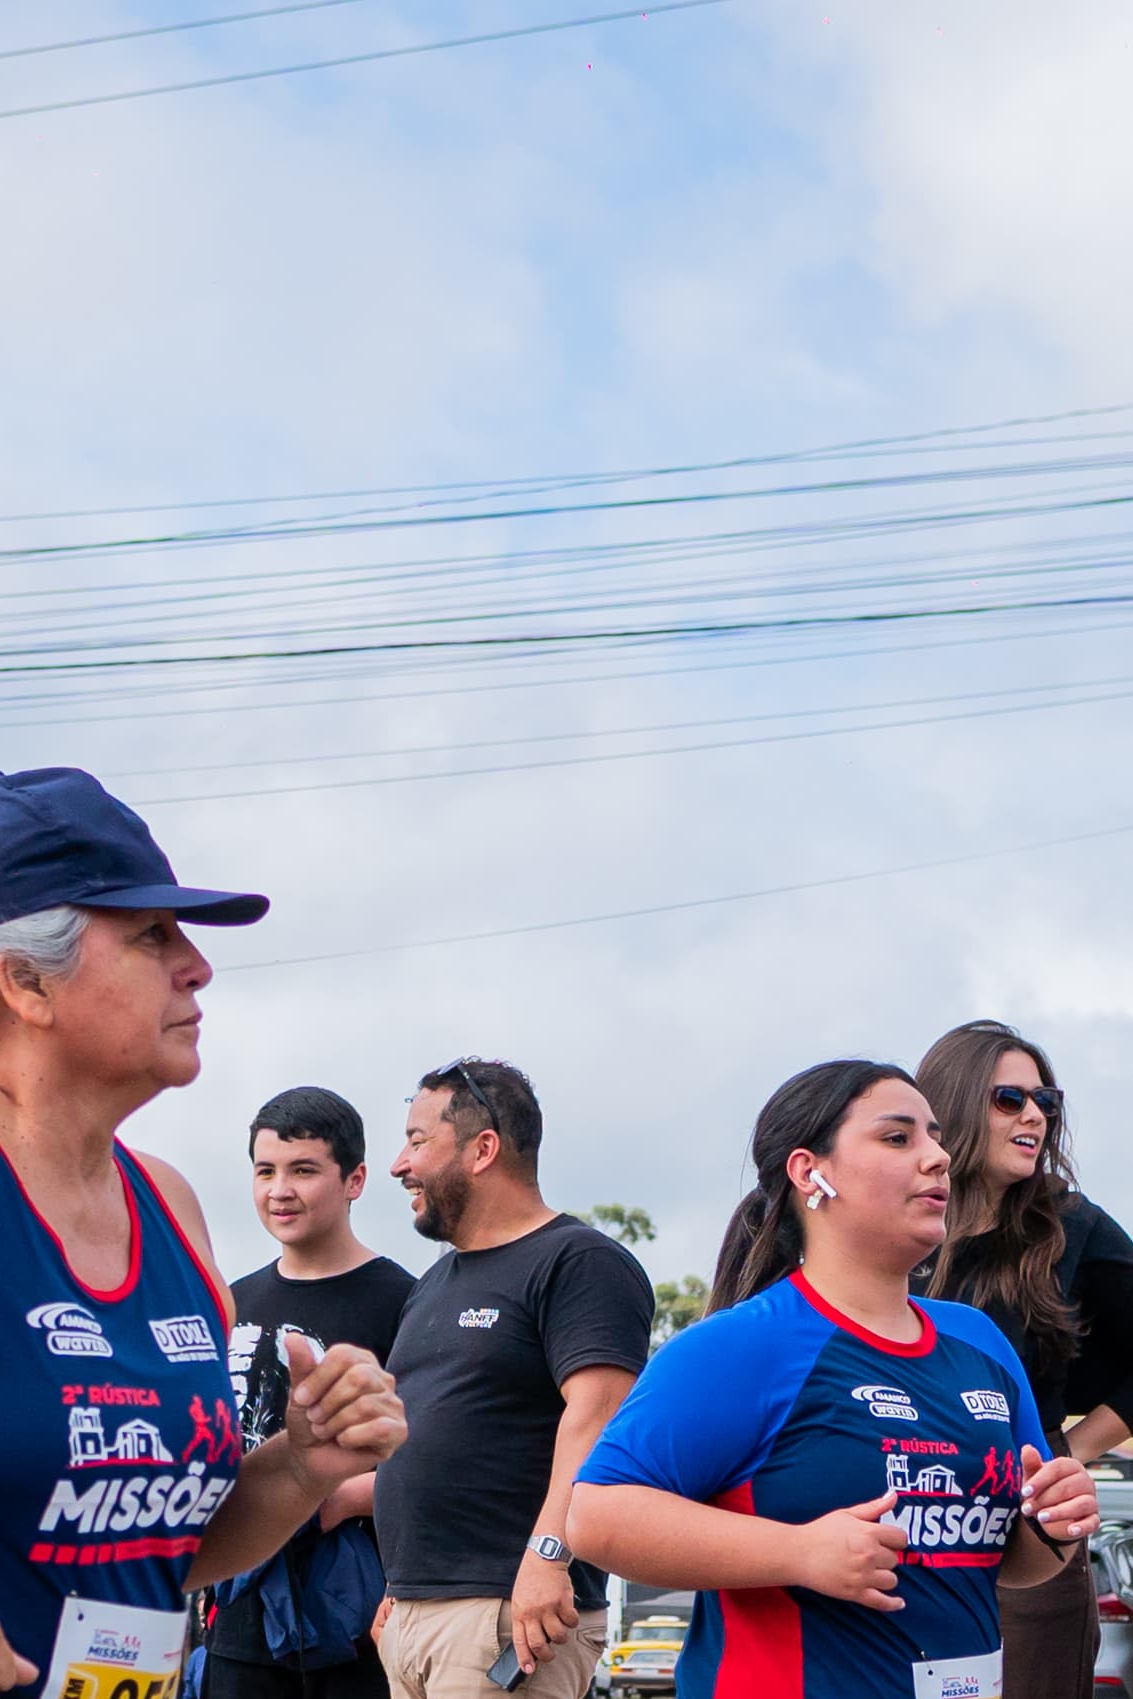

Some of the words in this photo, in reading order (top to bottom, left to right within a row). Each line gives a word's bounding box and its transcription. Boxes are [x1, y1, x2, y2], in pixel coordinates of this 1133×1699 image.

[88, 1382, 161, 1407] RÚSTICA
[900, 1437, 959, 1455] RÚSTICA
[38, 1461, 237, 1534] MISSÕE
[87, 1645, 140, 1661] MISSÕES
[941, 1685, 979, 1698] MISSÕES
